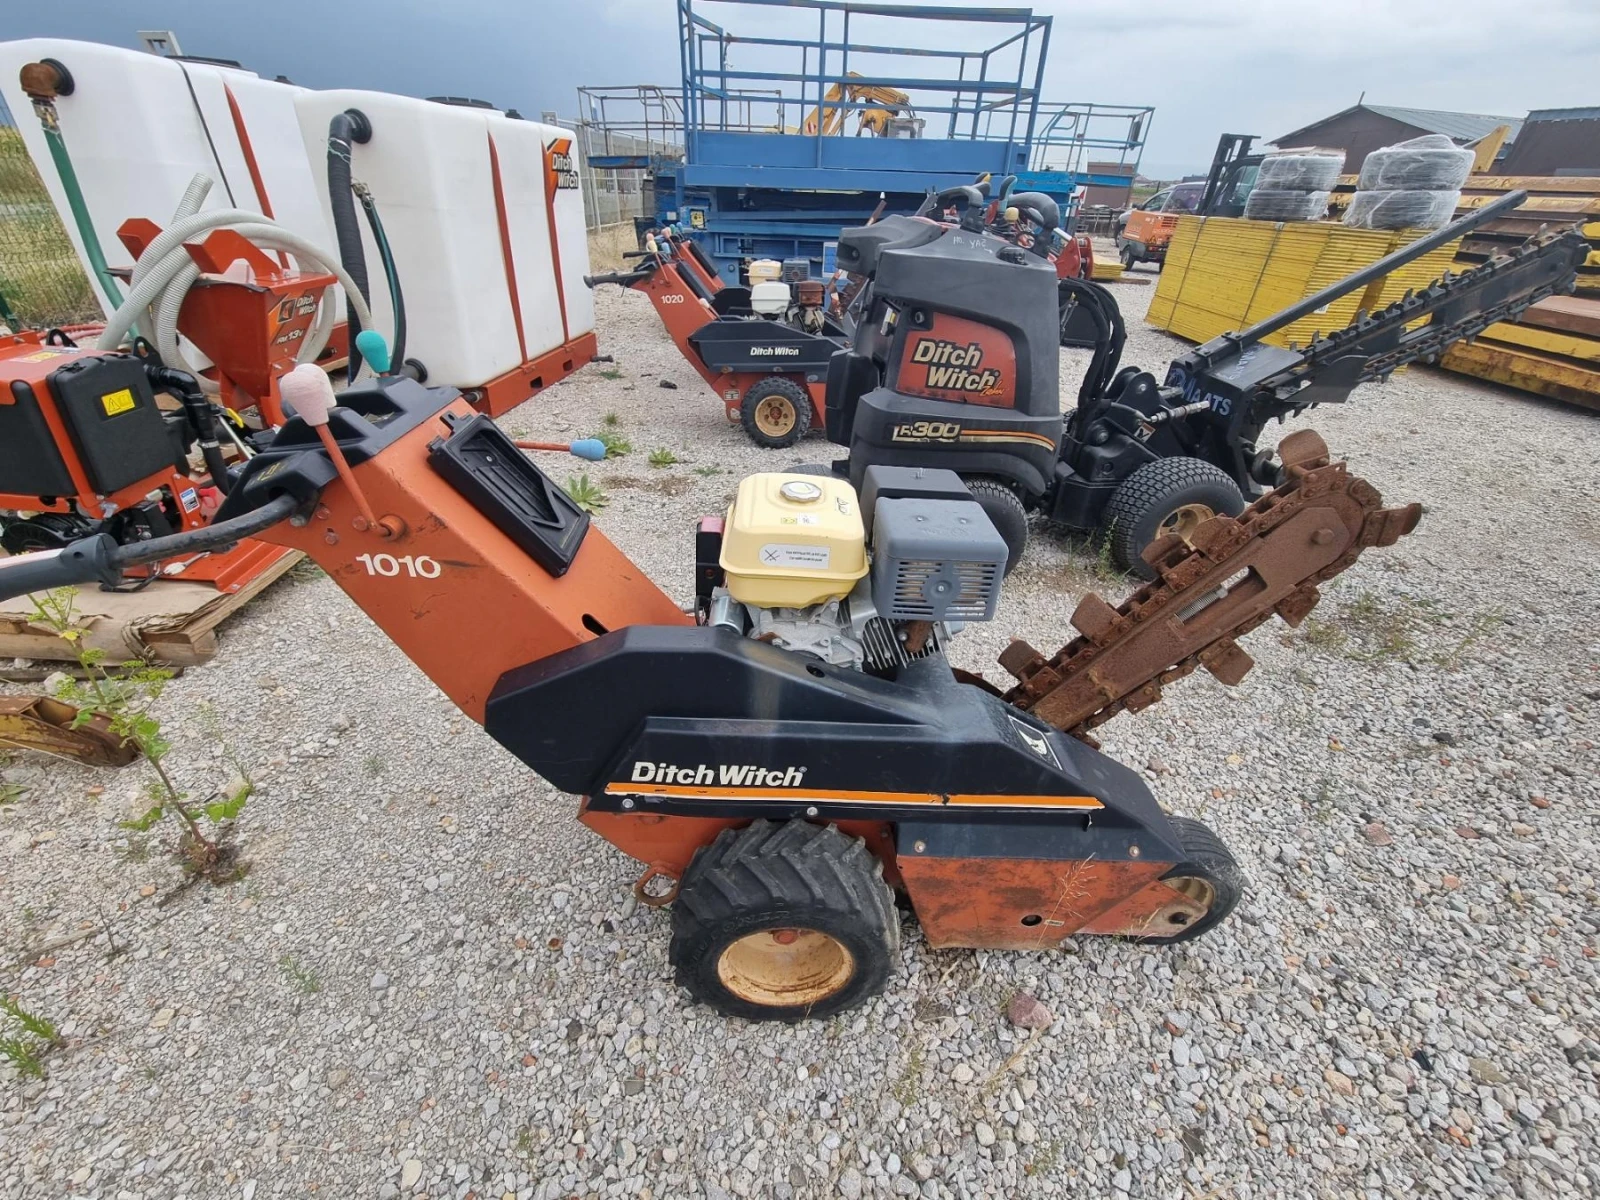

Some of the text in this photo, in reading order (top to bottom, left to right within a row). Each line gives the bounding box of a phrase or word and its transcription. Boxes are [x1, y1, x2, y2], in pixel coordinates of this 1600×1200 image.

[552, 153, 572, 171] Ditch
[557, 171, 578, 188] Witch
[661, 294, 684, 304] 1020
[750, 347, 799, 356] Ditch Witch
[913, 340, 982, 368] Ditch
[927, 366, 996, 391] Witch
[355, 553, 441, 579] 1010
[631, 761, 803, 787] Ditch Witch
